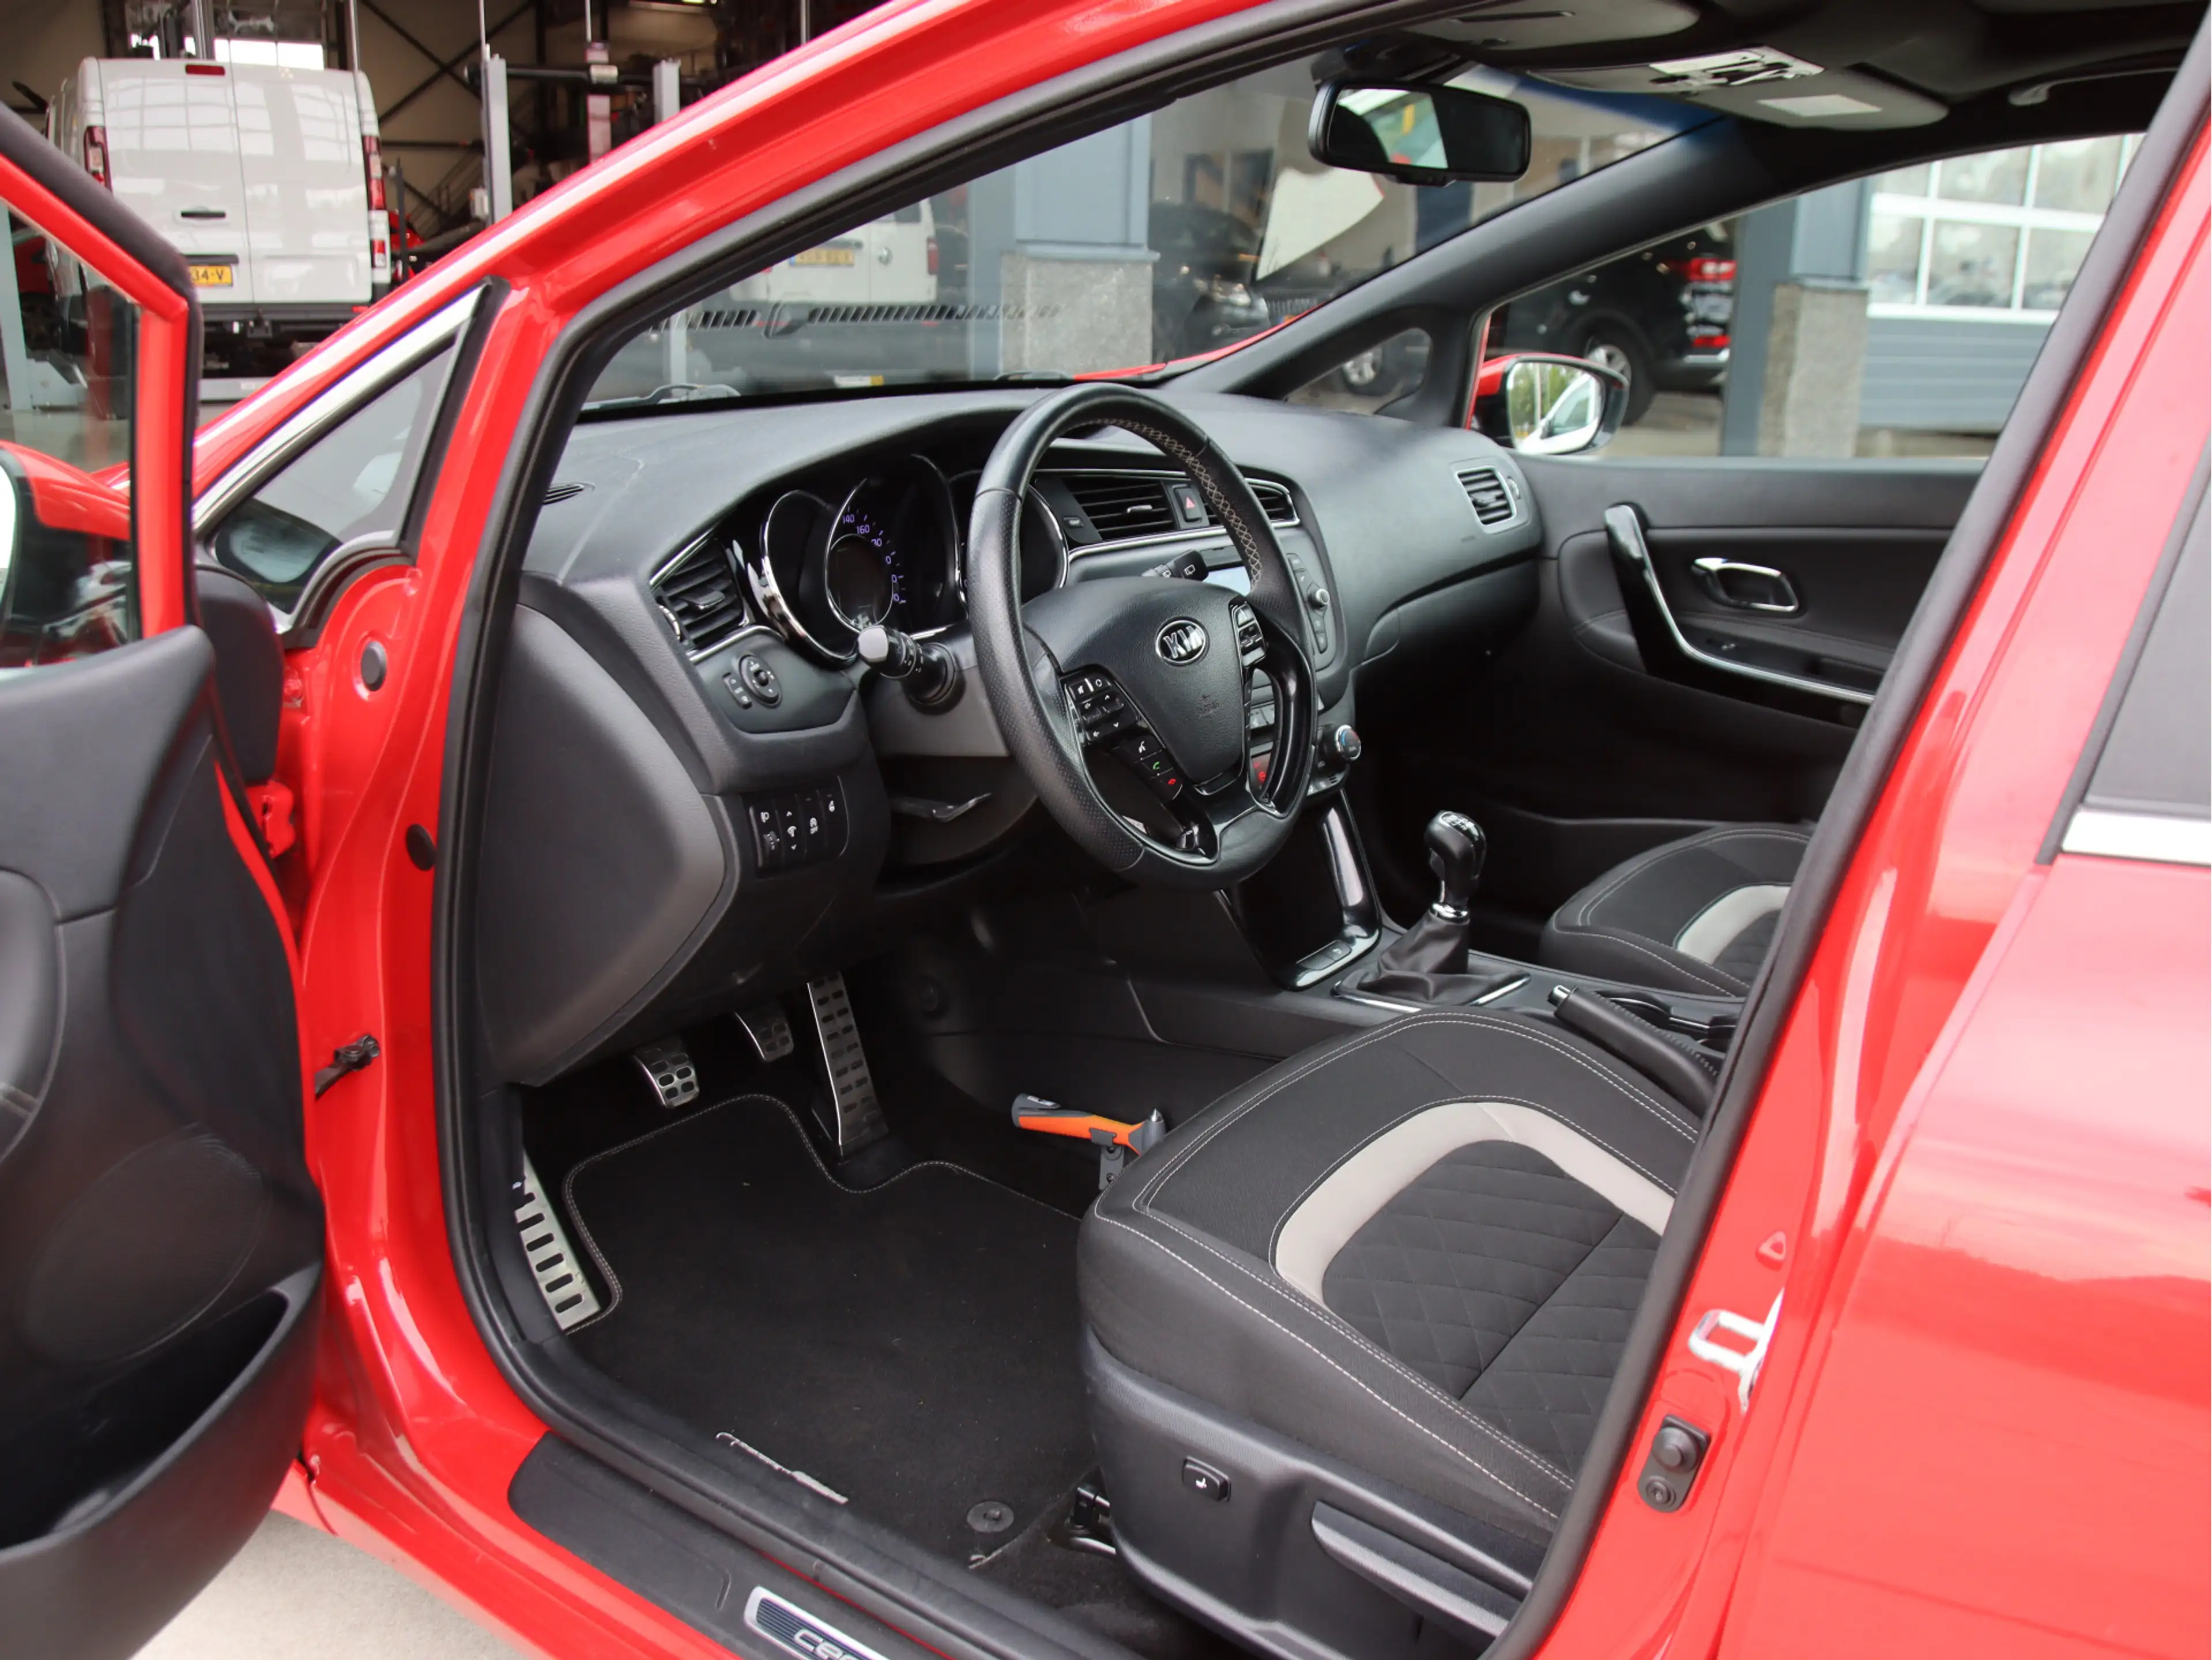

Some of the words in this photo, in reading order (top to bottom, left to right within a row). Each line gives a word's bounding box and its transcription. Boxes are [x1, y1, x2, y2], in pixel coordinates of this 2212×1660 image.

[842, 514, 854, 525] 140
[856, 524, 870, 534] 160
[1162, 625, 1205, 659] KIA
[793, 1628, 857, 1660] ce
